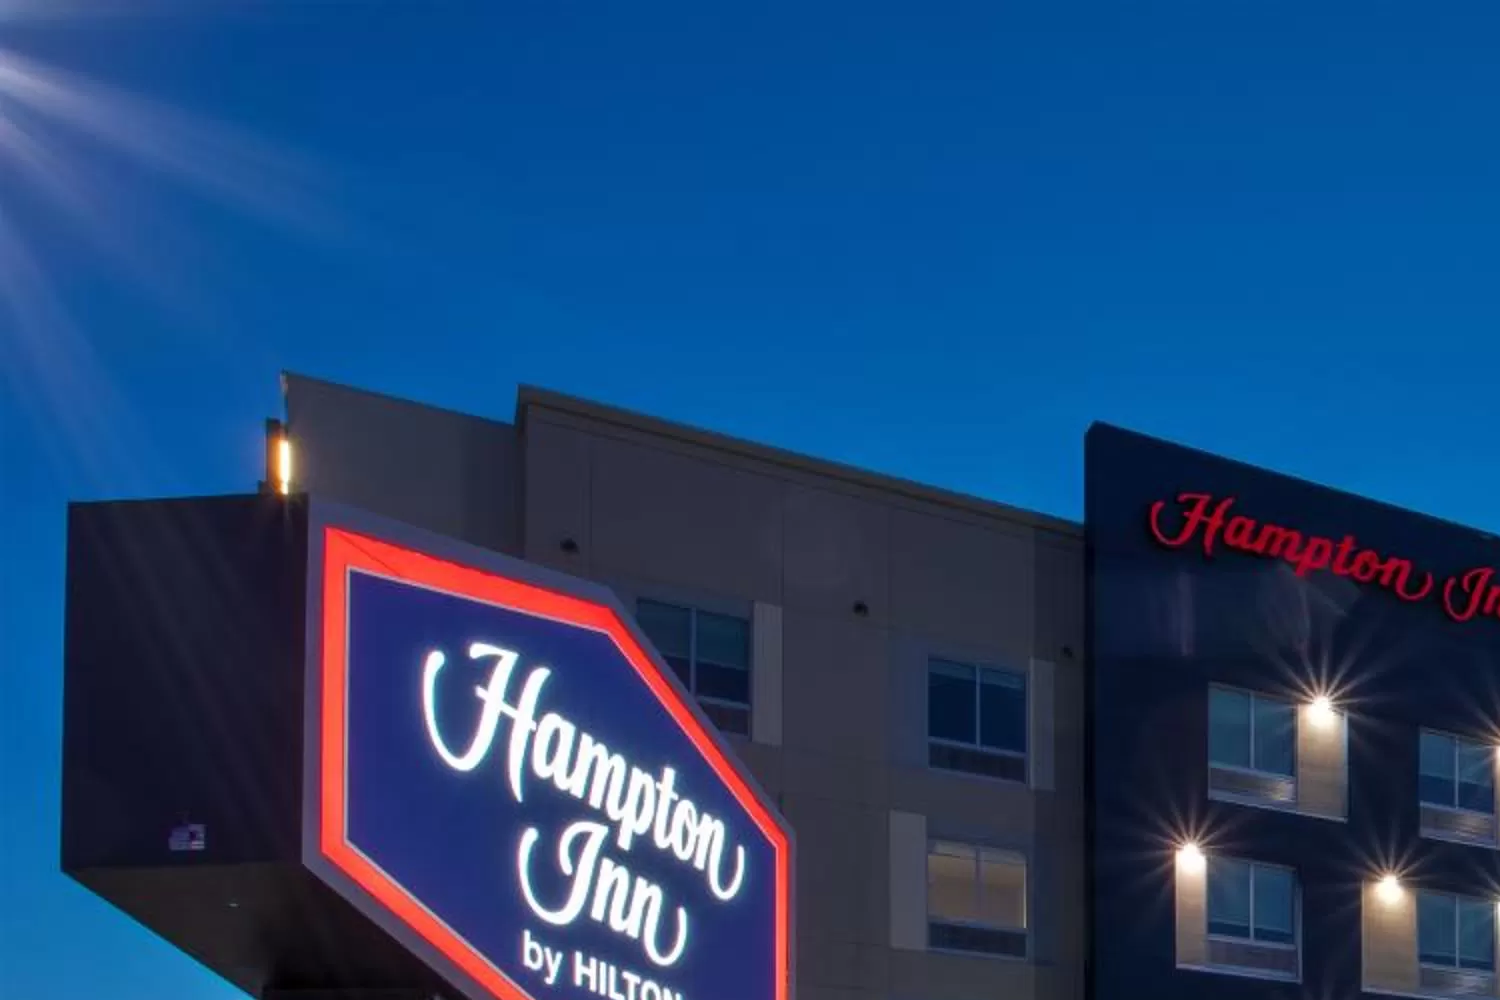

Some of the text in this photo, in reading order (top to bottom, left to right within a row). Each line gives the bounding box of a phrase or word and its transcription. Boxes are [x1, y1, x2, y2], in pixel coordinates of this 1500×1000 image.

[1149, 493, 1432, 600] Hampton
[422, 642, 744, 899] Hampton
[519, 821, 687, 966] Inn
[523, 929, 562, 985] by
